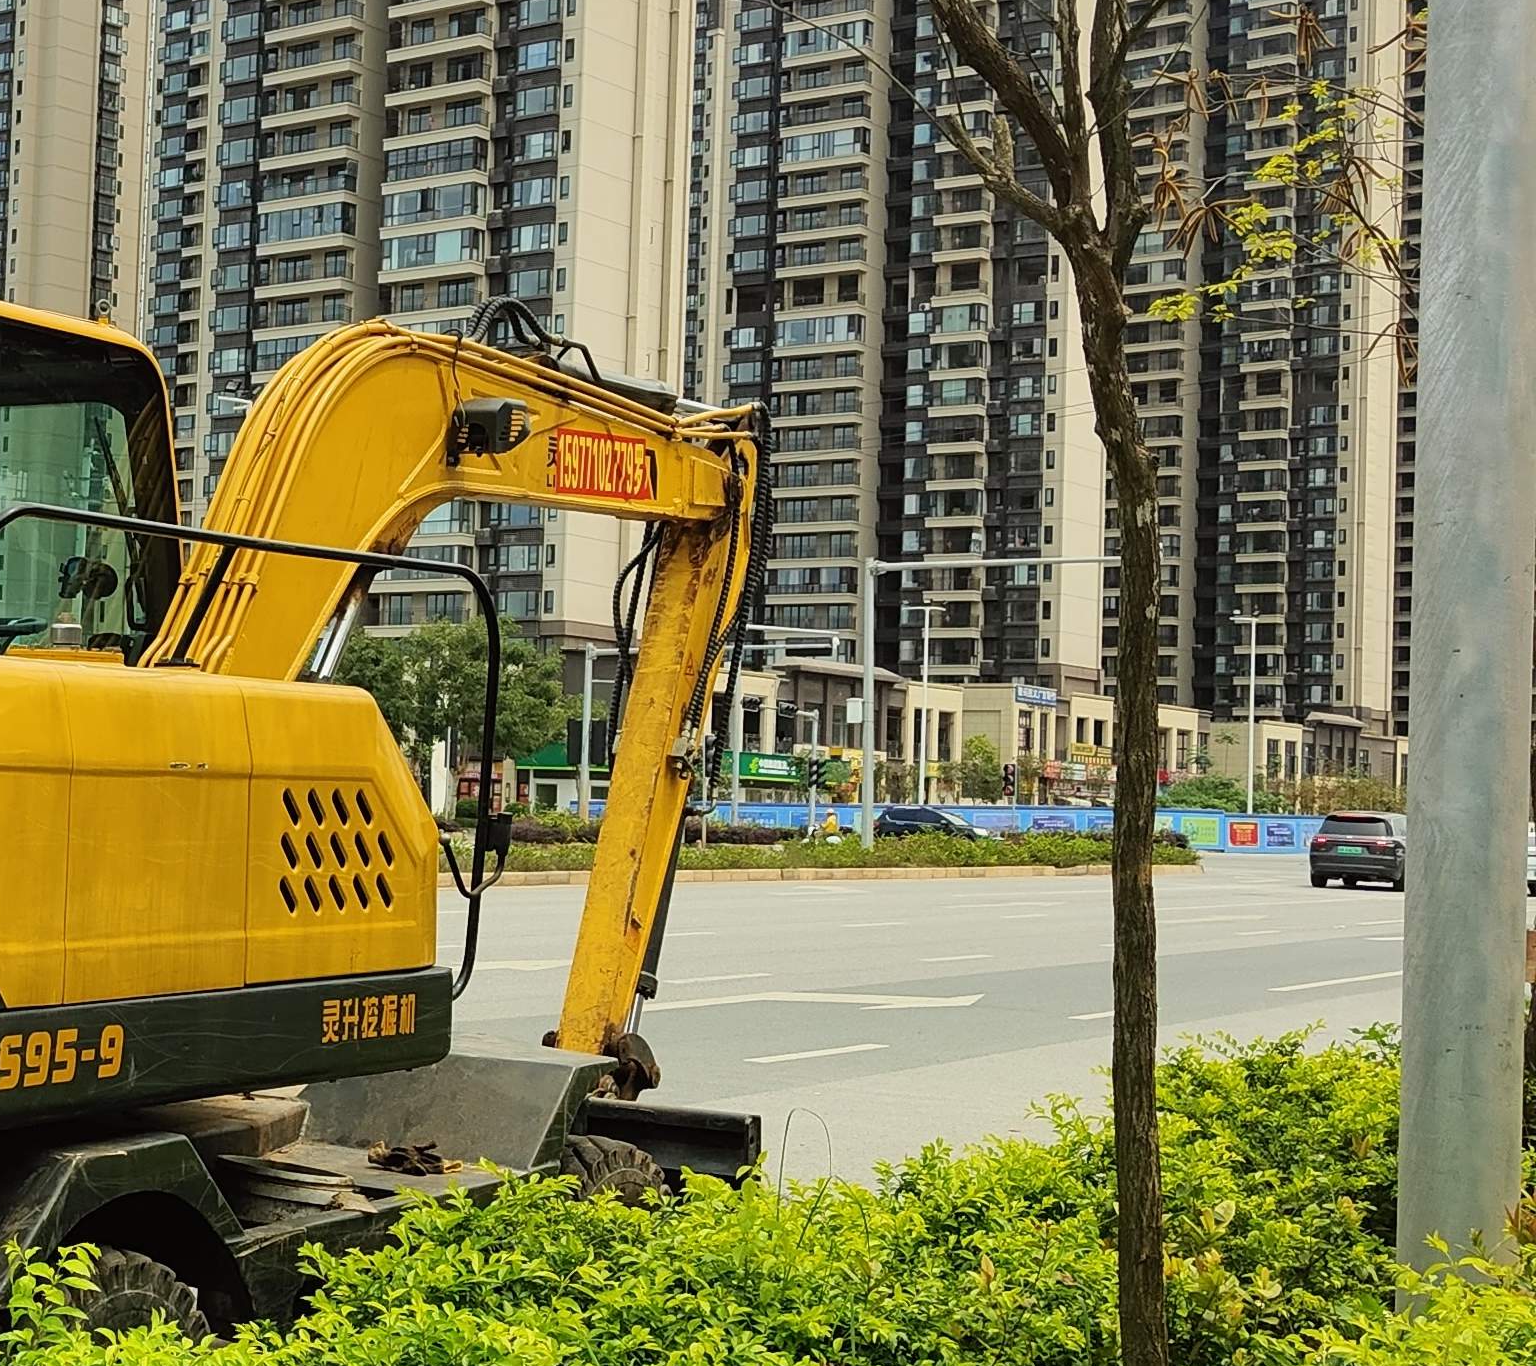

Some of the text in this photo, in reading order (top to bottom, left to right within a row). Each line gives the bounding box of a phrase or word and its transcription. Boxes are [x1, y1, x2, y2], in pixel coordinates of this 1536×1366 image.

[321, 992, 417, 1044] 灵升挖掘机
